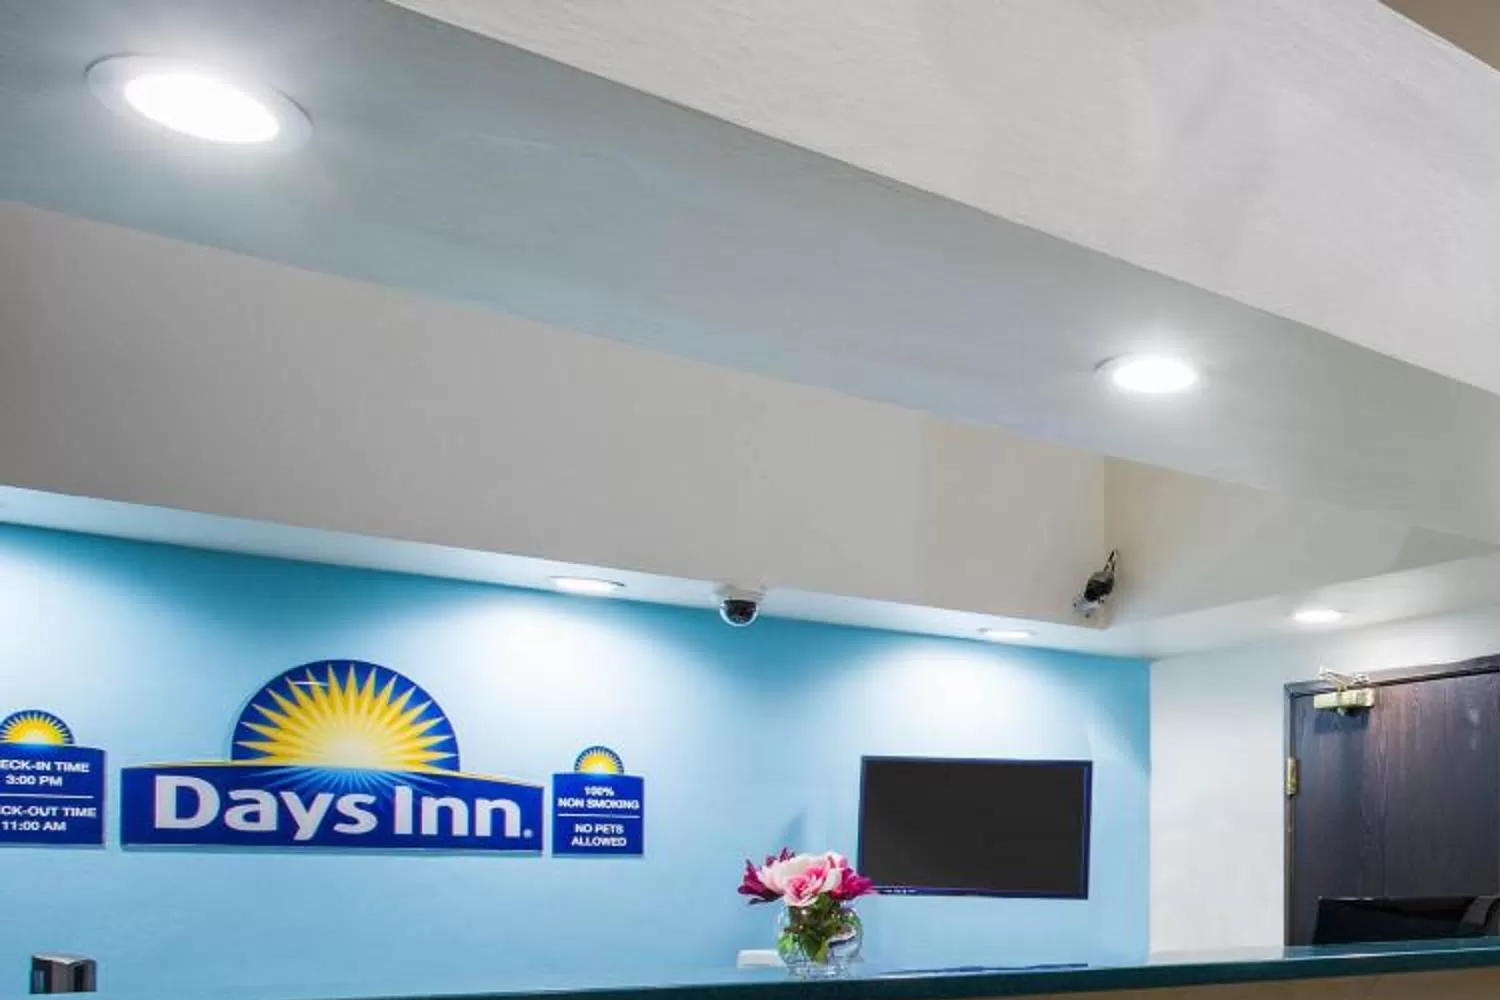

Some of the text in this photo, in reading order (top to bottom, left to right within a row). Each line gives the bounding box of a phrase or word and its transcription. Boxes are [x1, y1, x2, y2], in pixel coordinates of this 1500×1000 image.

[0, 760, 90, 773] ECK-IN TIME
[5, 775, 63, 787] 3:00 PM
[153, 775, 379, 841] Days
[557, 798, 640, 809] NON SMOKING
[0, 805, 97, 818] CK-OUT TIME
[1, 821, 67, 831] 11:00 AM
[575, 823, 624, 835] NO PETS
[571, 836, 628, 847] ALLOWED
